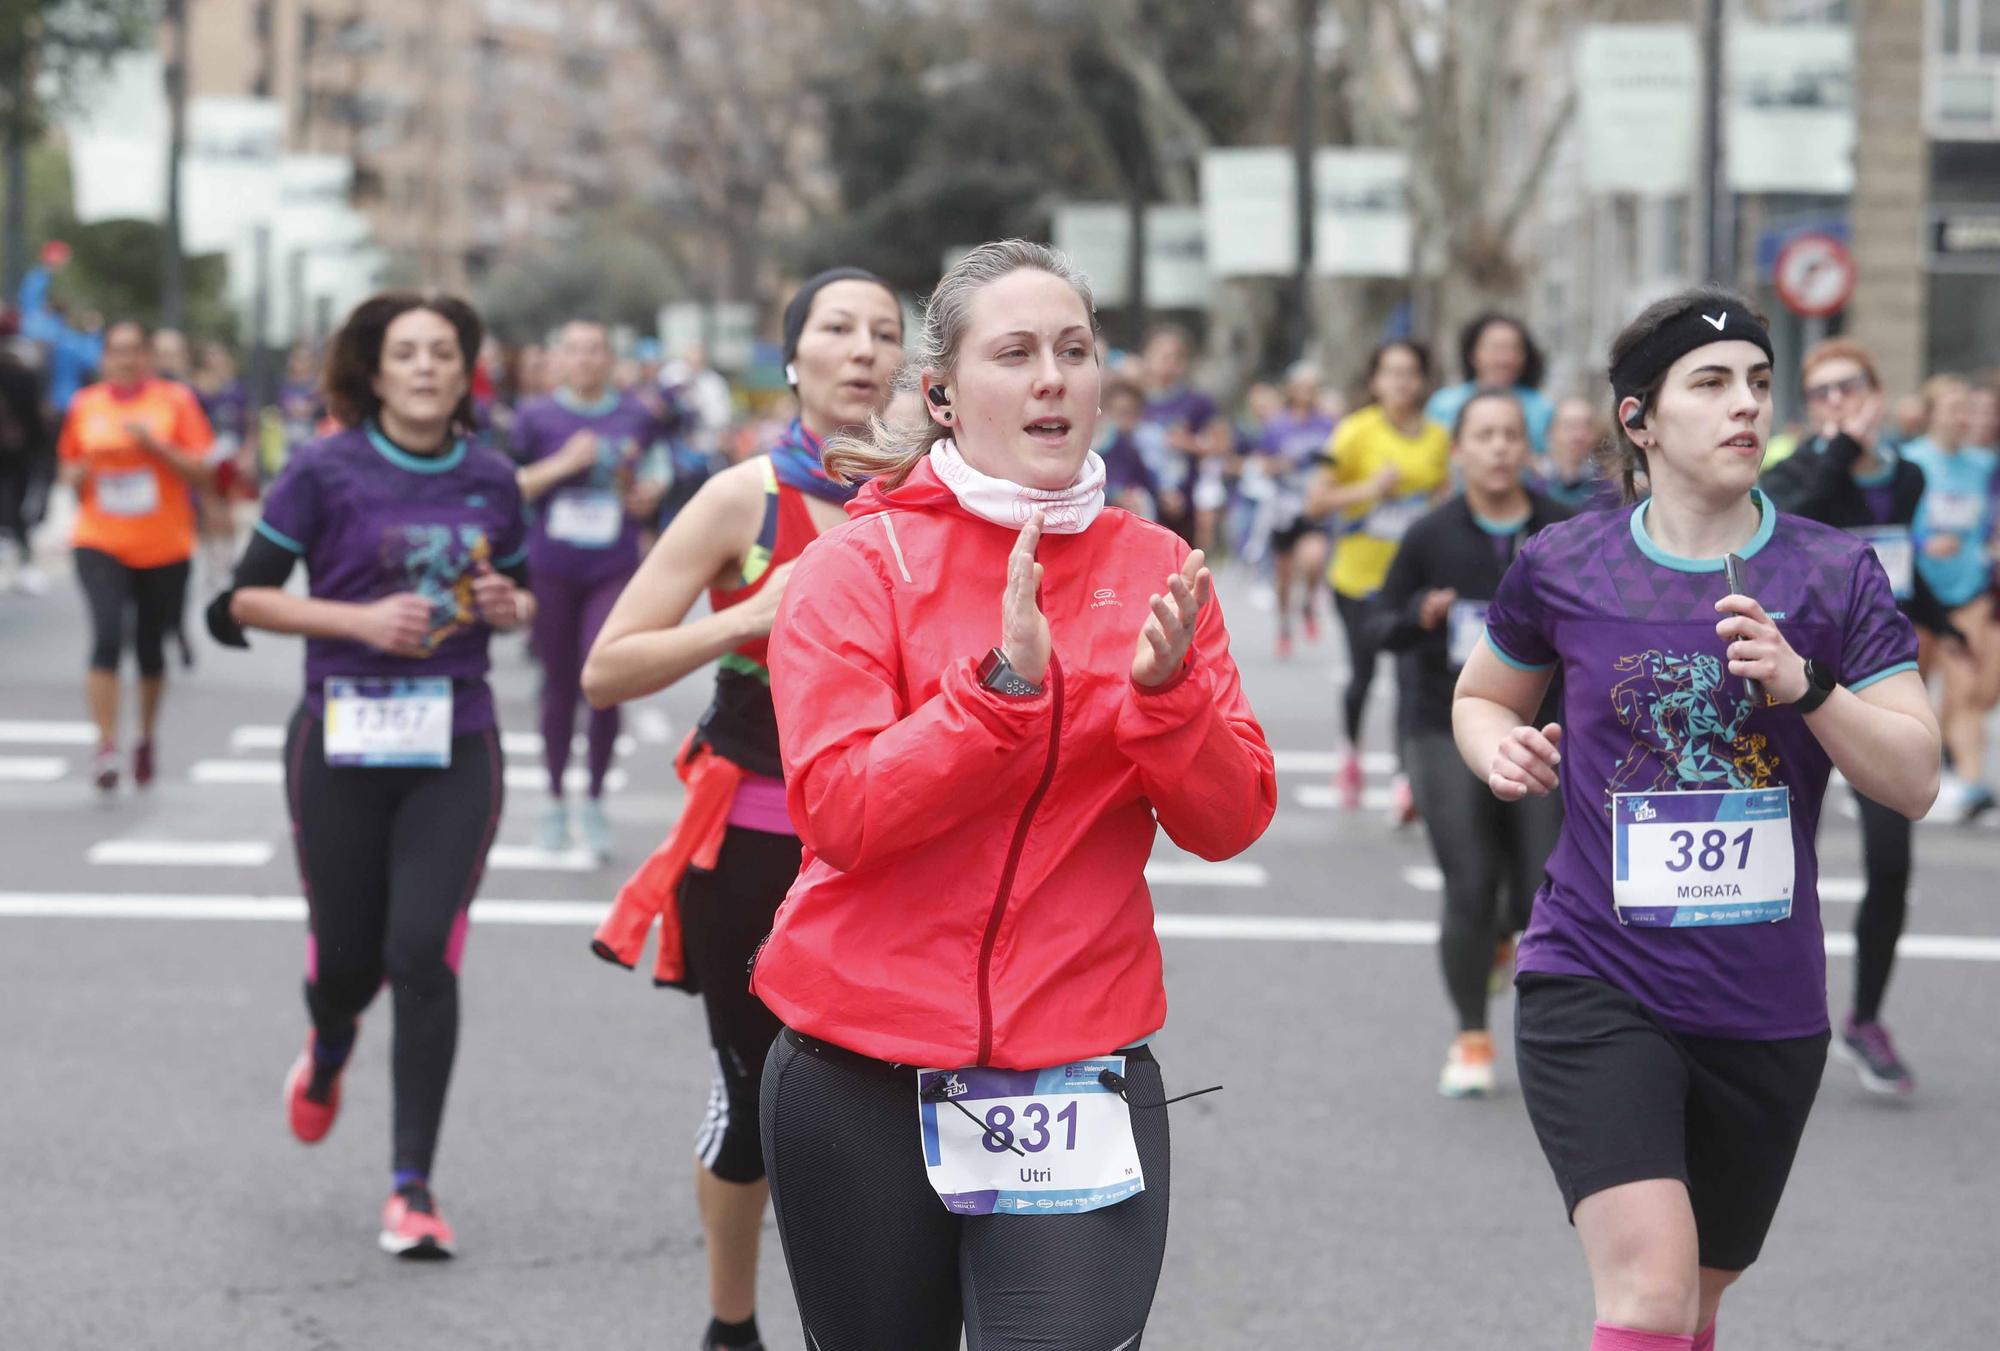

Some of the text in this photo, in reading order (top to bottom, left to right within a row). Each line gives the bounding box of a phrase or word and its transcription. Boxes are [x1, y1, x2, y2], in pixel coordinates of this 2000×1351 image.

[1665, 827, 1753, 872] 381
[1677, 884, 1742, 898] MORATA
[1065, 1066, 1073, 1078] 6
[982, 1100, 1078, 1153] 831
[1020, 1168, 1051, 1183] Utri
[1124, 1168, 1134, 1176] M
